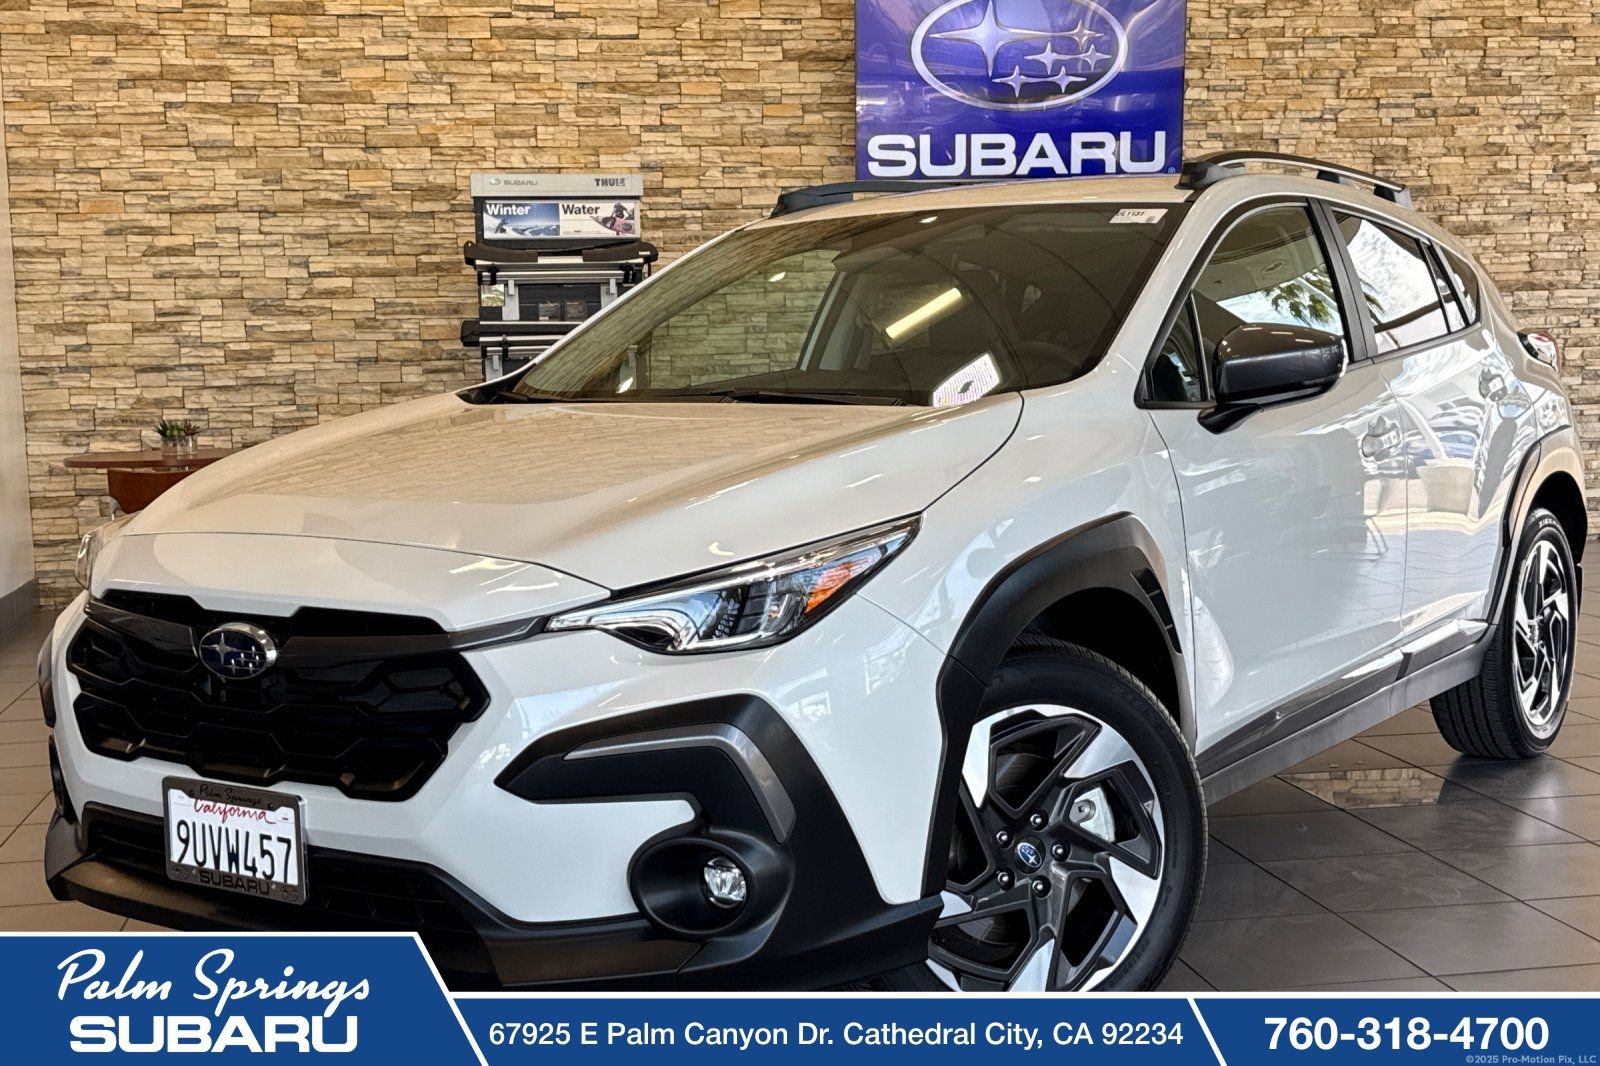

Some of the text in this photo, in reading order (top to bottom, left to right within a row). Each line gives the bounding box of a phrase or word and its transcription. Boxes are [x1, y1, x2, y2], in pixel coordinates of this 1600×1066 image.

[868, 131, 1166, 177] SUBARU
[503, 179, 538, 187] SUBARU
[594, 177, 626, 187] THULE
[486, 203, 531, 216] Winter
[562, 203, 600, 215] Water
[199, 783, 222, 801] Palm
[194, 799, 276, 824] California
[177, 819, 292, 884] 9UVW457
[199, 870, 270, 896] SUBARU
